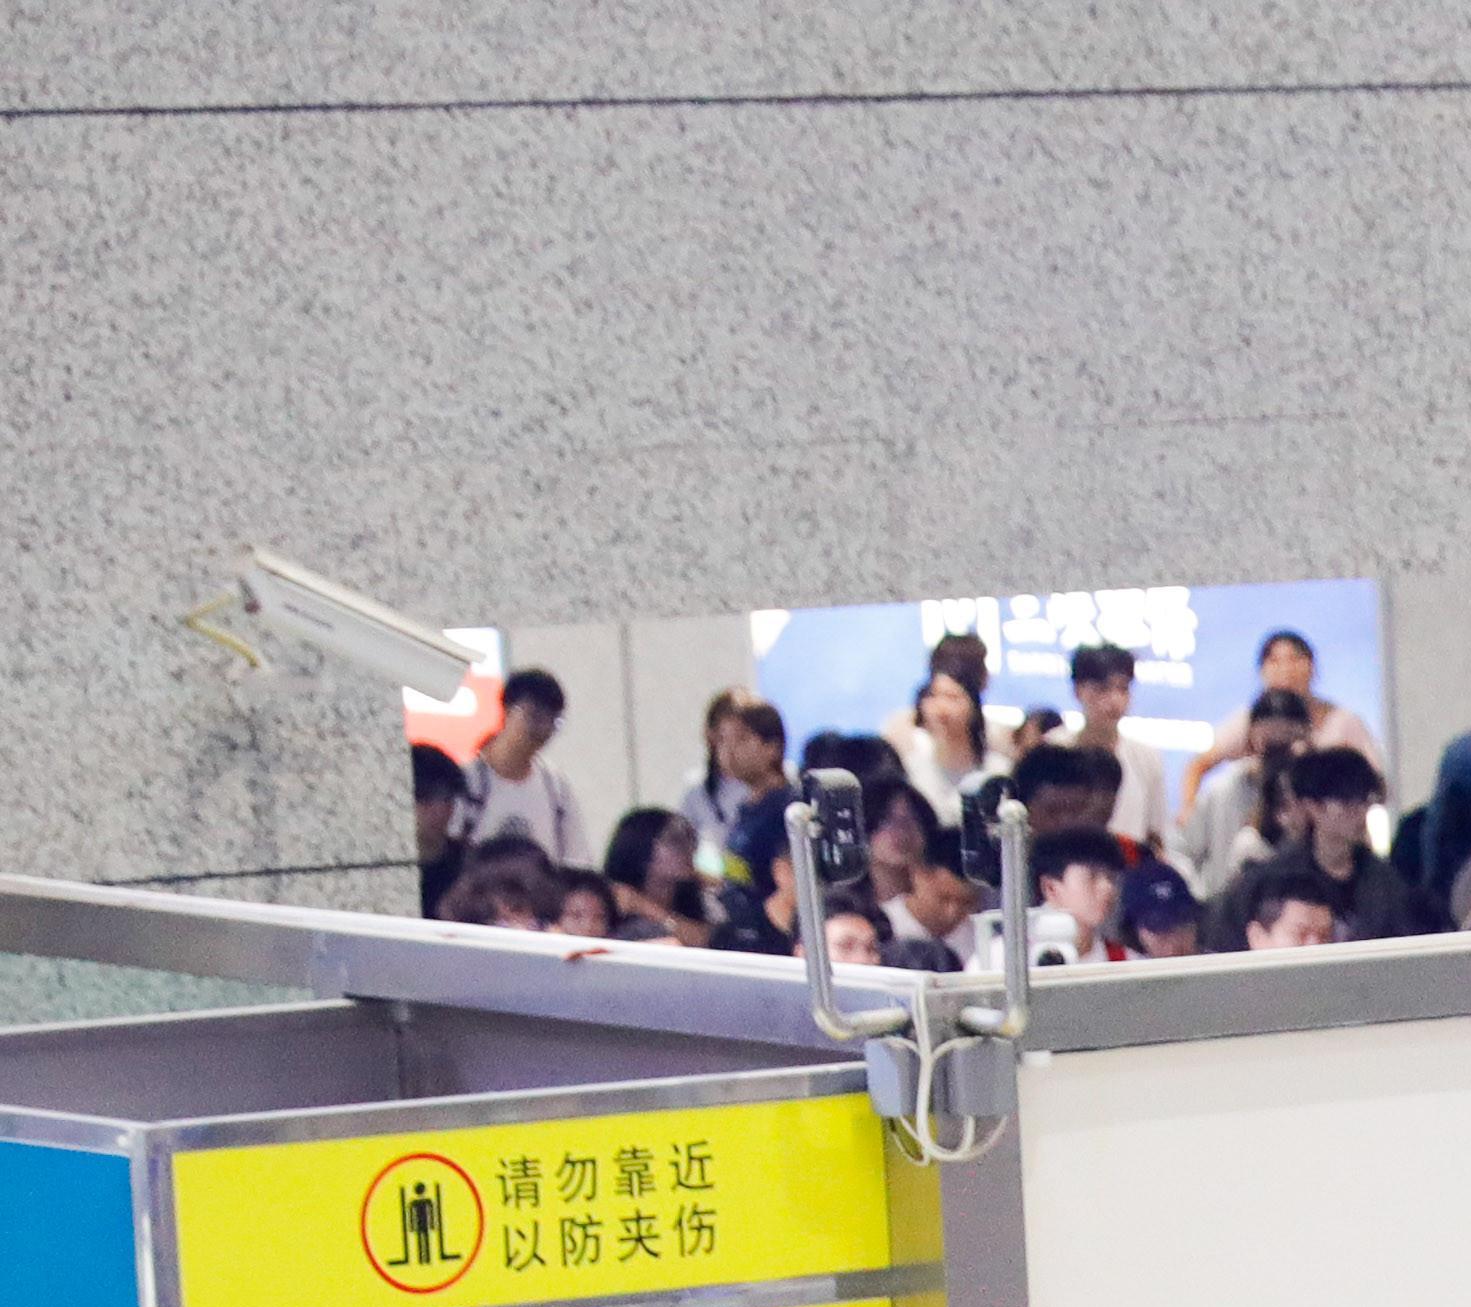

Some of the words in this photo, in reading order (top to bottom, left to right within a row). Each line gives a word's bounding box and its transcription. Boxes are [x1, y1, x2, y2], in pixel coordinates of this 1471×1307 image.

[497, 1139, 716, 1206] 请勿靠近
[500, 1204, 719, 1274] 以防夹伤
